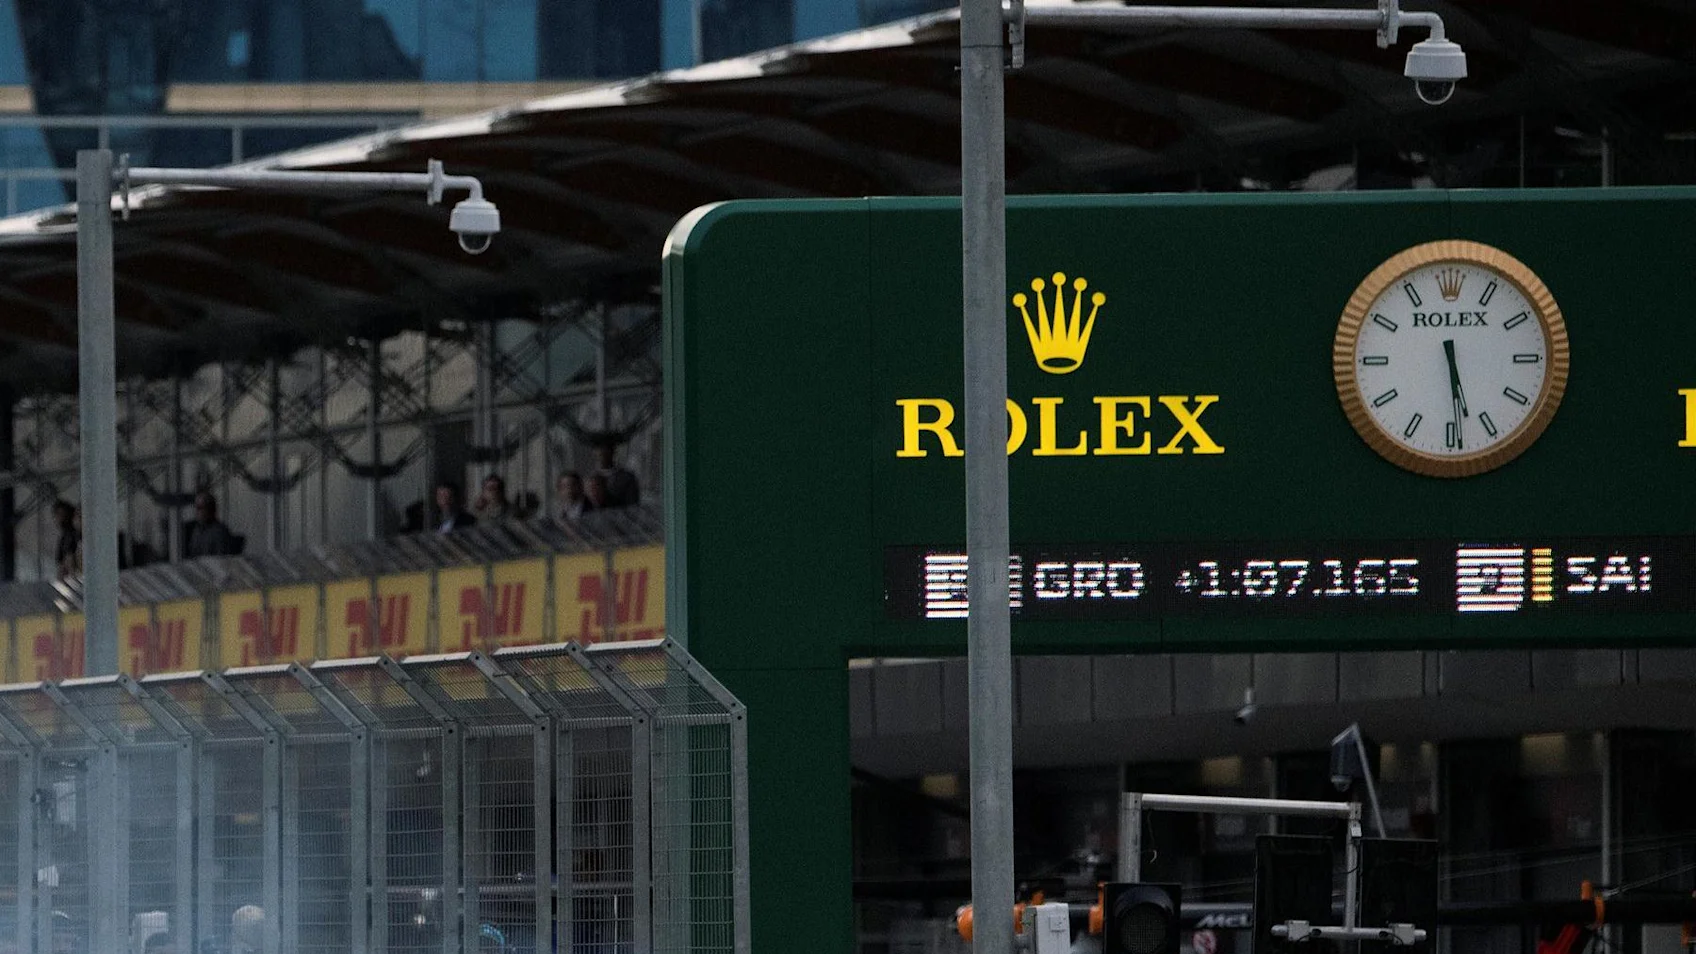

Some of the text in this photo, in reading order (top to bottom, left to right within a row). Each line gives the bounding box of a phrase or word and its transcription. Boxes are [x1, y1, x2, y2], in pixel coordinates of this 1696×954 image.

[1412, 311, 1489, 327] ROLEX
[1034, 561, 1145, 598] GRO
[1566, 556, 1651, 592] SAI
